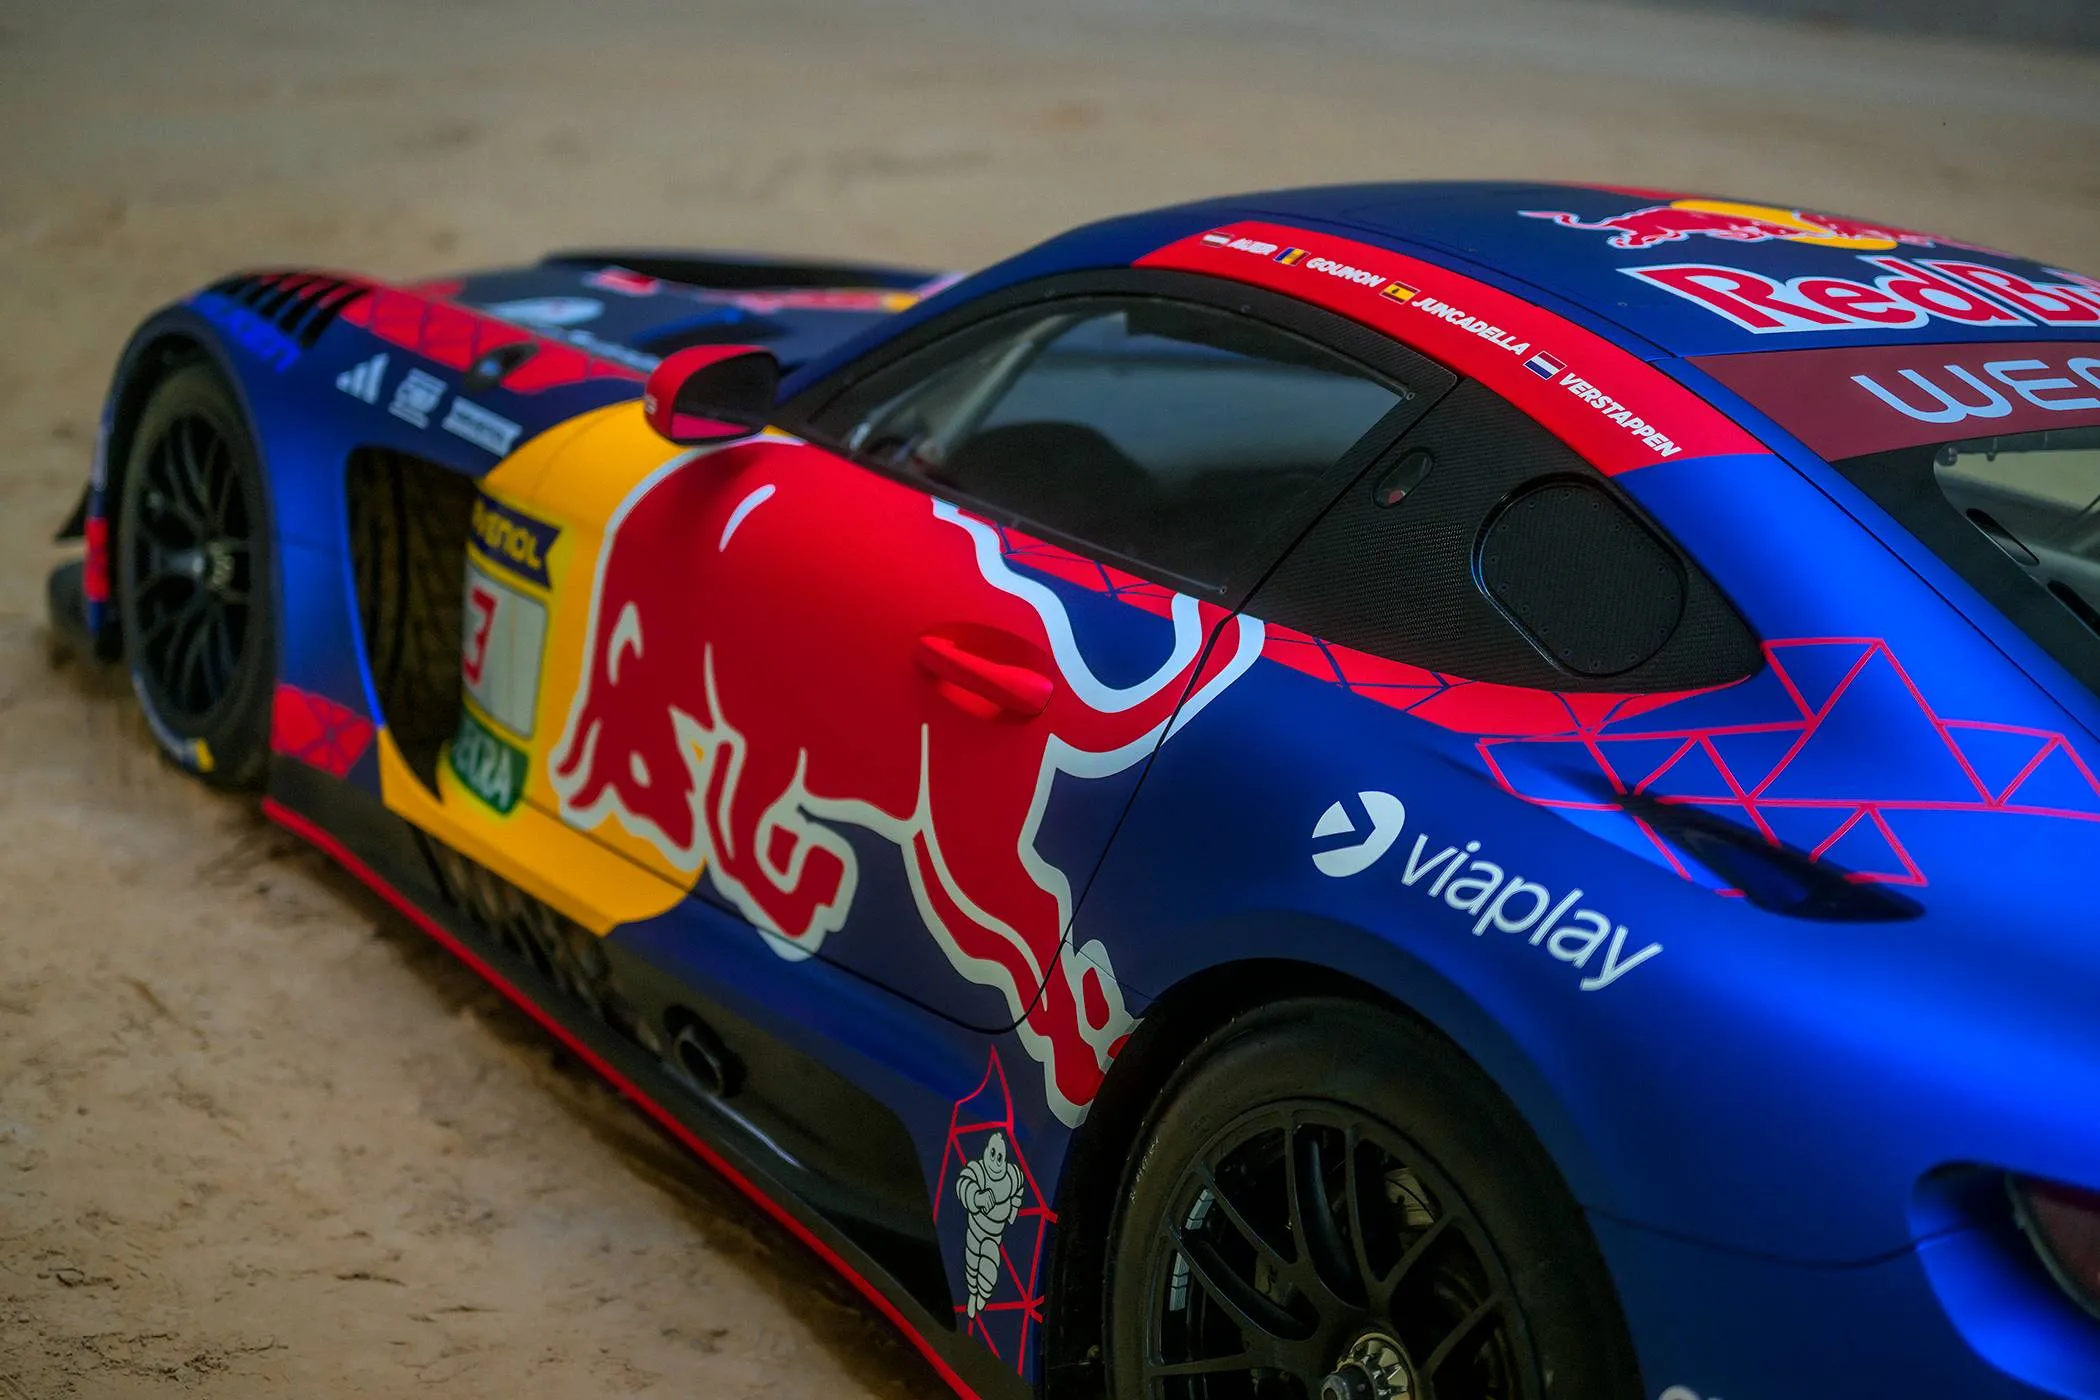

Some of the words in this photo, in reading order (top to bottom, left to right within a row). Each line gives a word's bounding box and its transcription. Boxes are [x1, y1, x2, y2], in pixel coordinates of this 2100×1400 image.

[1306, 257, 1386, 288] GOUNON
[1412, 297, 1531, 356] JUNCADELLA
[1560, 372, 1683, 458] VERSTAPPEN
[1615, 254, 2038, 334] Red
[1401, 833, 1664, 991] viaplay
